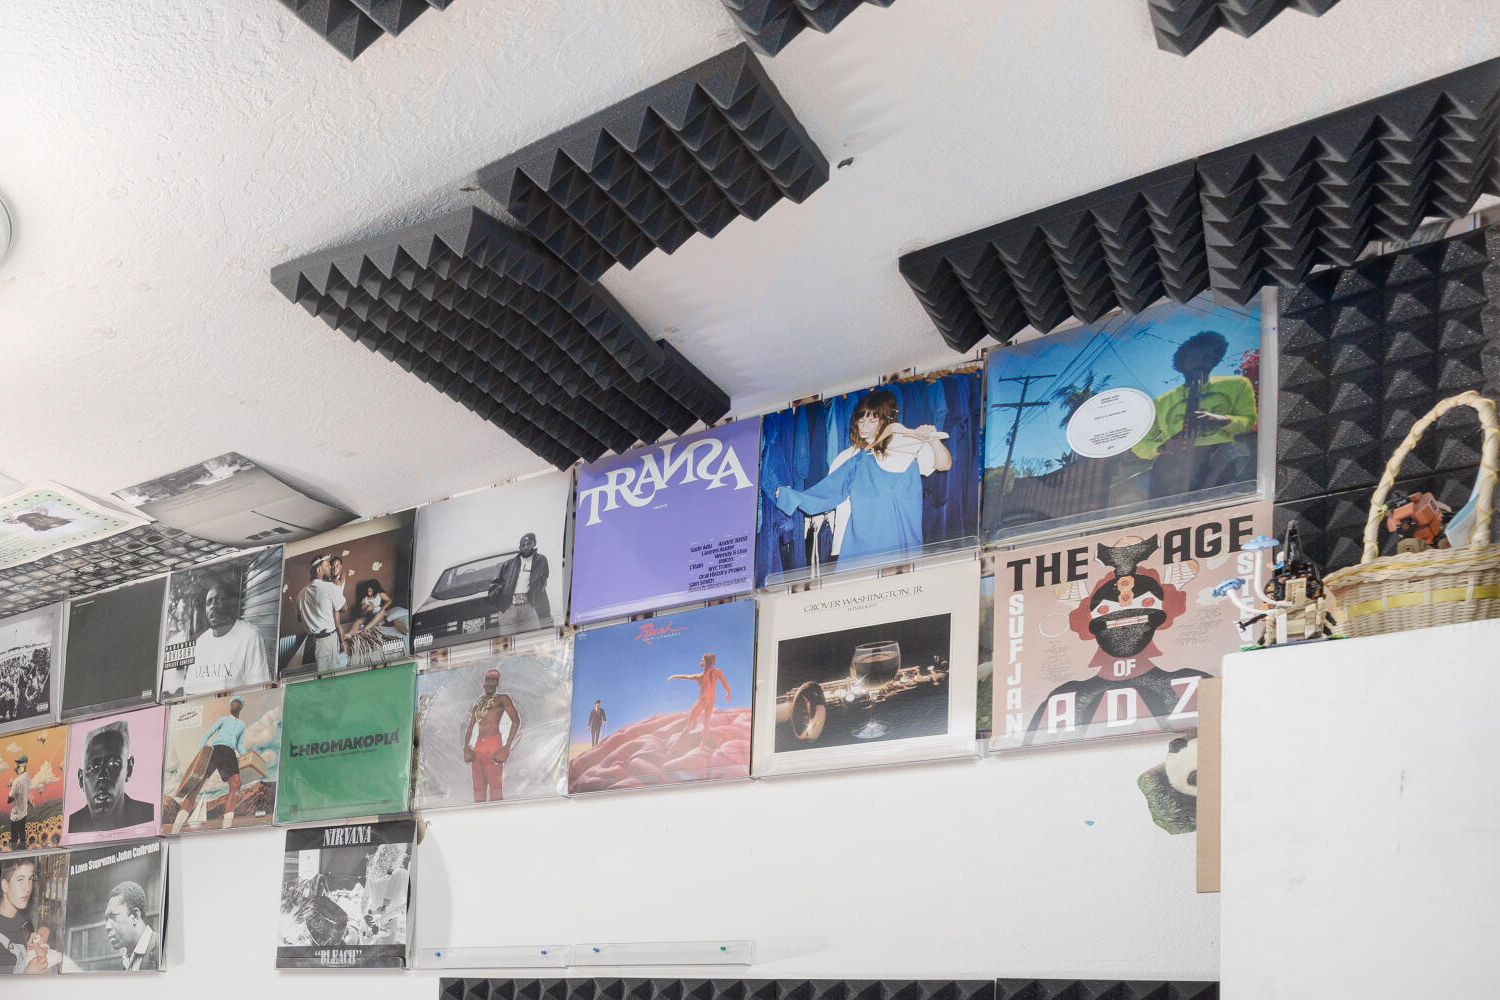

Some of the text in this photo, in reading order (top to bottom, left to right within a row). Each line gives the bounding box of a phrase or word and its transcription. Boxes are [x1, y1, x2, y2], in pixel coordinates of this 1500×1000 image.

[1006, 514, 1253, 592] THE AGE
[803, 600, 841, 613] GROVER
[165, 647, 196, 664] ADVISORY
[1004, 594, 1024, 738] SUFJAN
[1113, 658, 1136, 677] OF
[289, 728, 400, 758] CHROMAKOPIA
[323, 825, 372, 847] NIRVANA
[70, 865, 75, 875] A
[75, 861, 89, 874] Love
[132, 842, 160, 858] Coltrane
